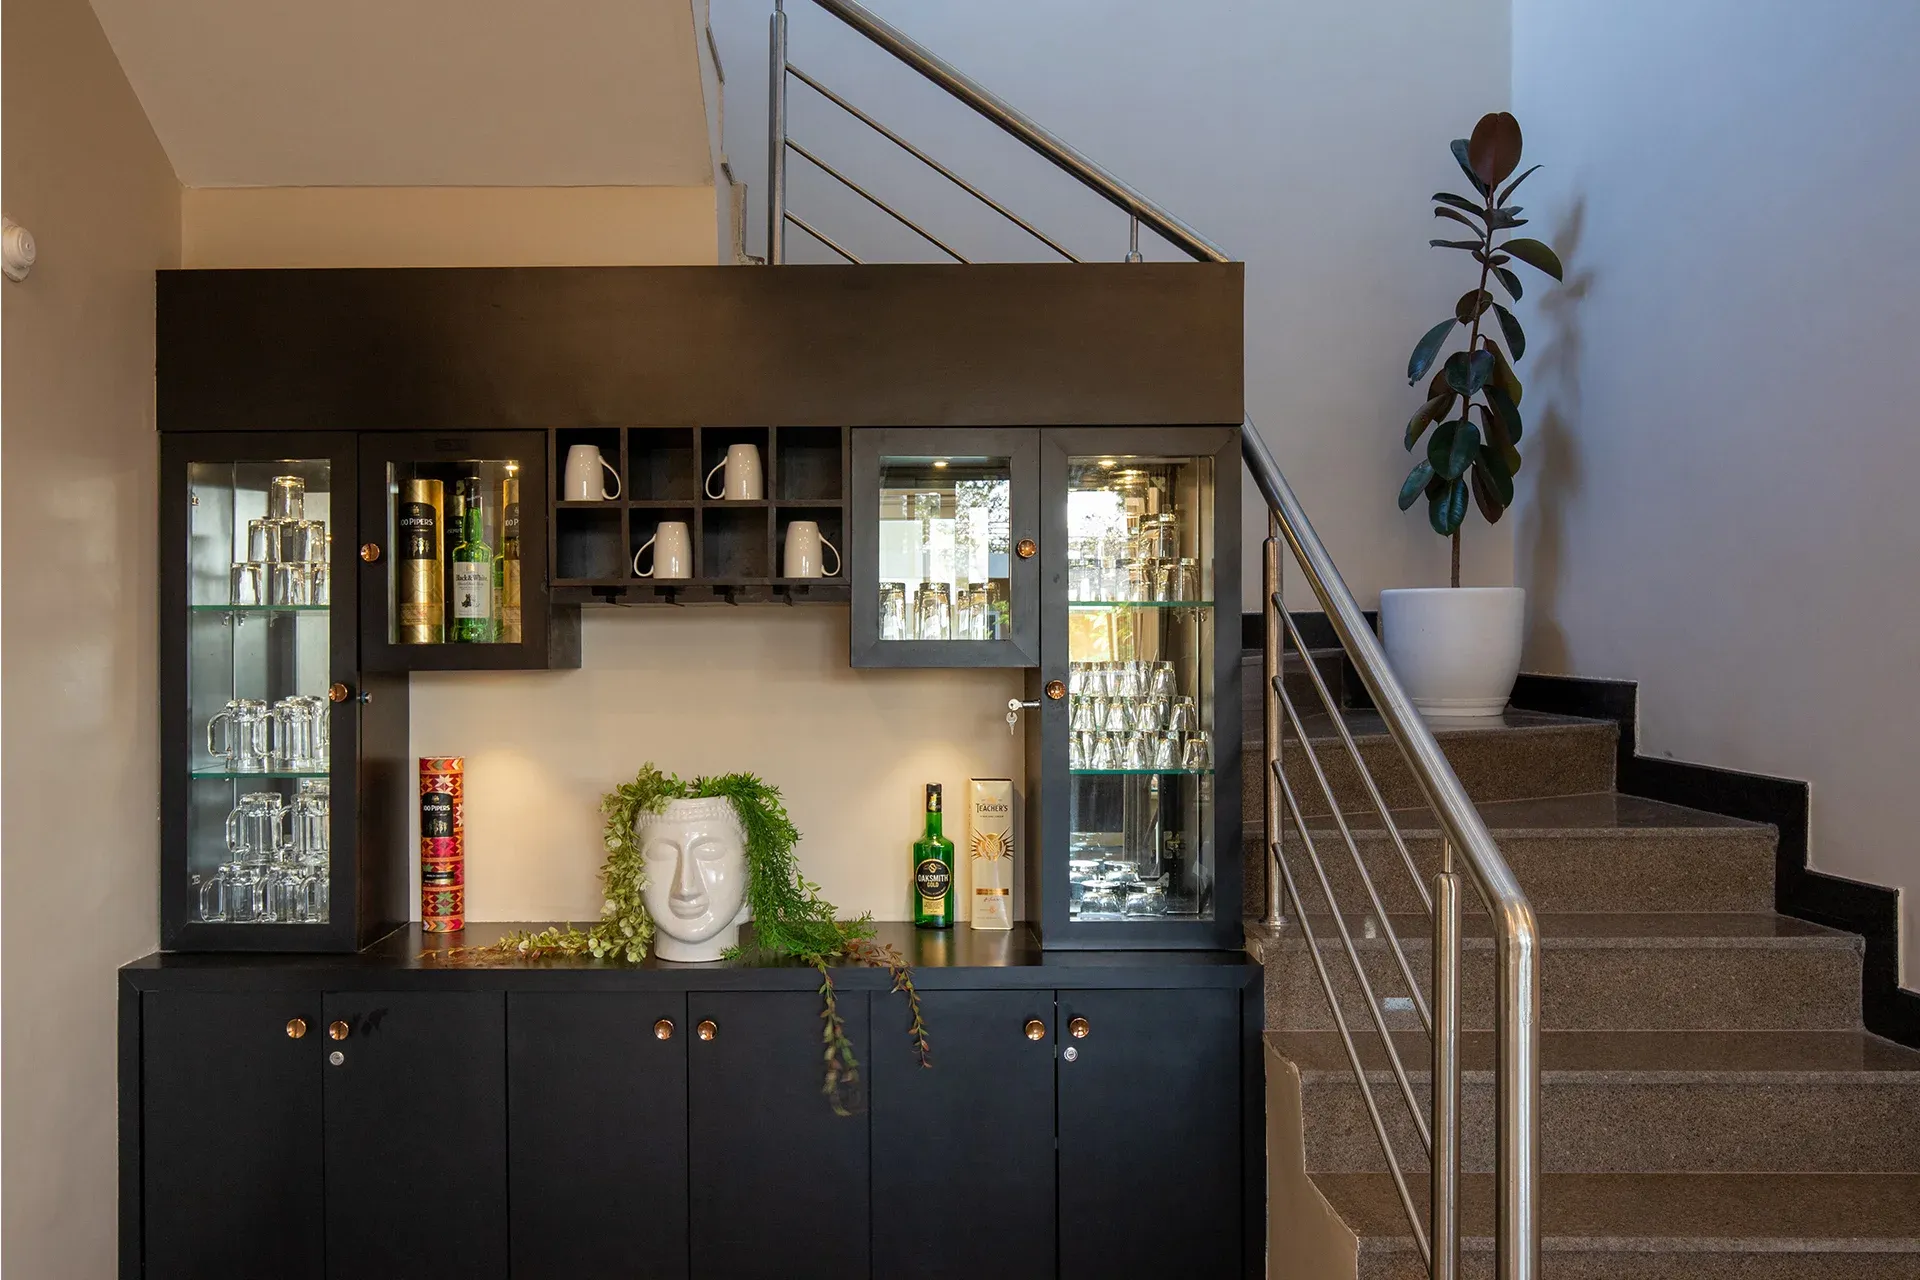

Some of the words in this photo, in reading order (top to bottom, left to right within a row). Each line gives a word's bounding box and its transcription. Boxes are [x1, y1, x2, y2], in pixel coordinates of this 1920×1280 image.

[409, 518, 433, 526] PIPERS
[431, 804, 450, 812] PIPERS
[976, 803, 1008, 813] TEACHER'S
[917, 874, 948, 882] OAKSMITH
